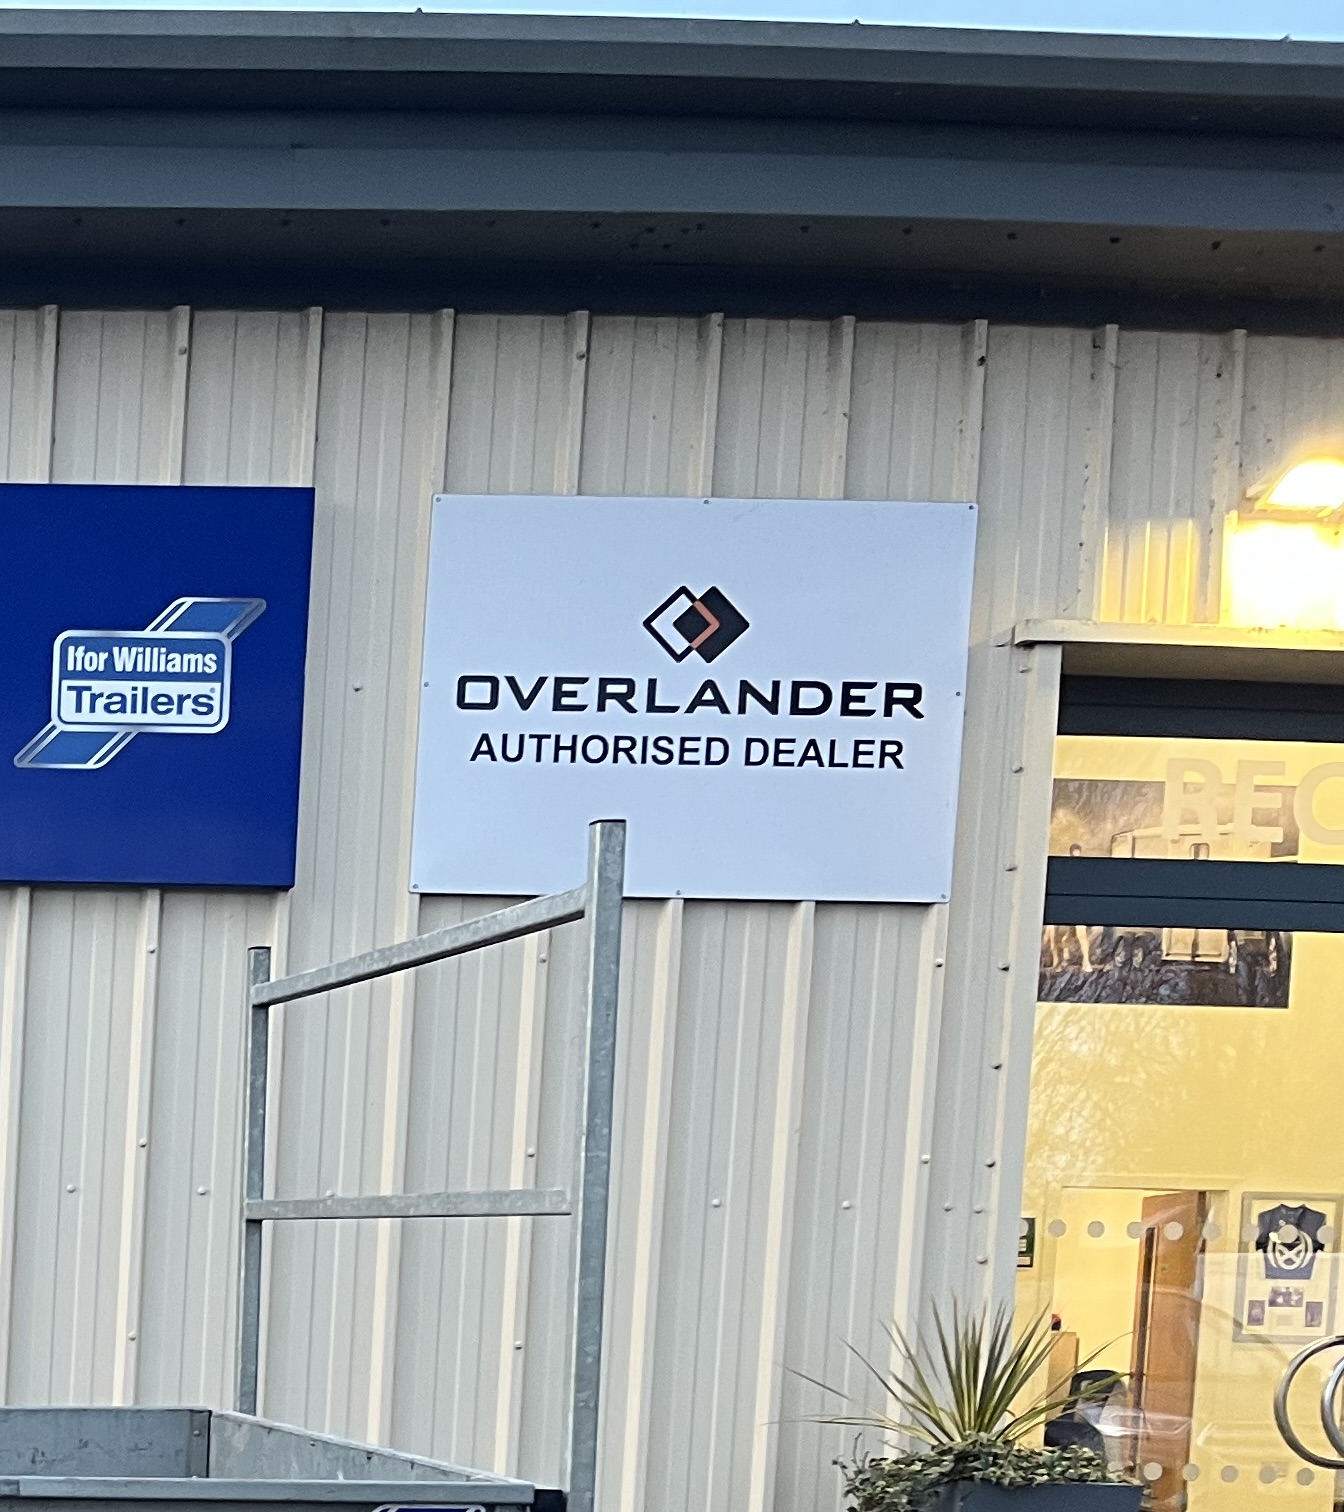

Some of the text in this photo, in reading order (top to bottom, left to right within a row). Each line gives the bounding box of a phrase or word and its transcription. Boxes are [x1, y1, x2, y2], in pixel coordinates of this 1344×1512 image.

[66, 645, 218, 674] Ifor Williams
[66, 685, 215, 716] Trailers
[456, 675, 925, 720] OVERLANDER
[469, 732, 904, 770] AUTHORISED DEALER
